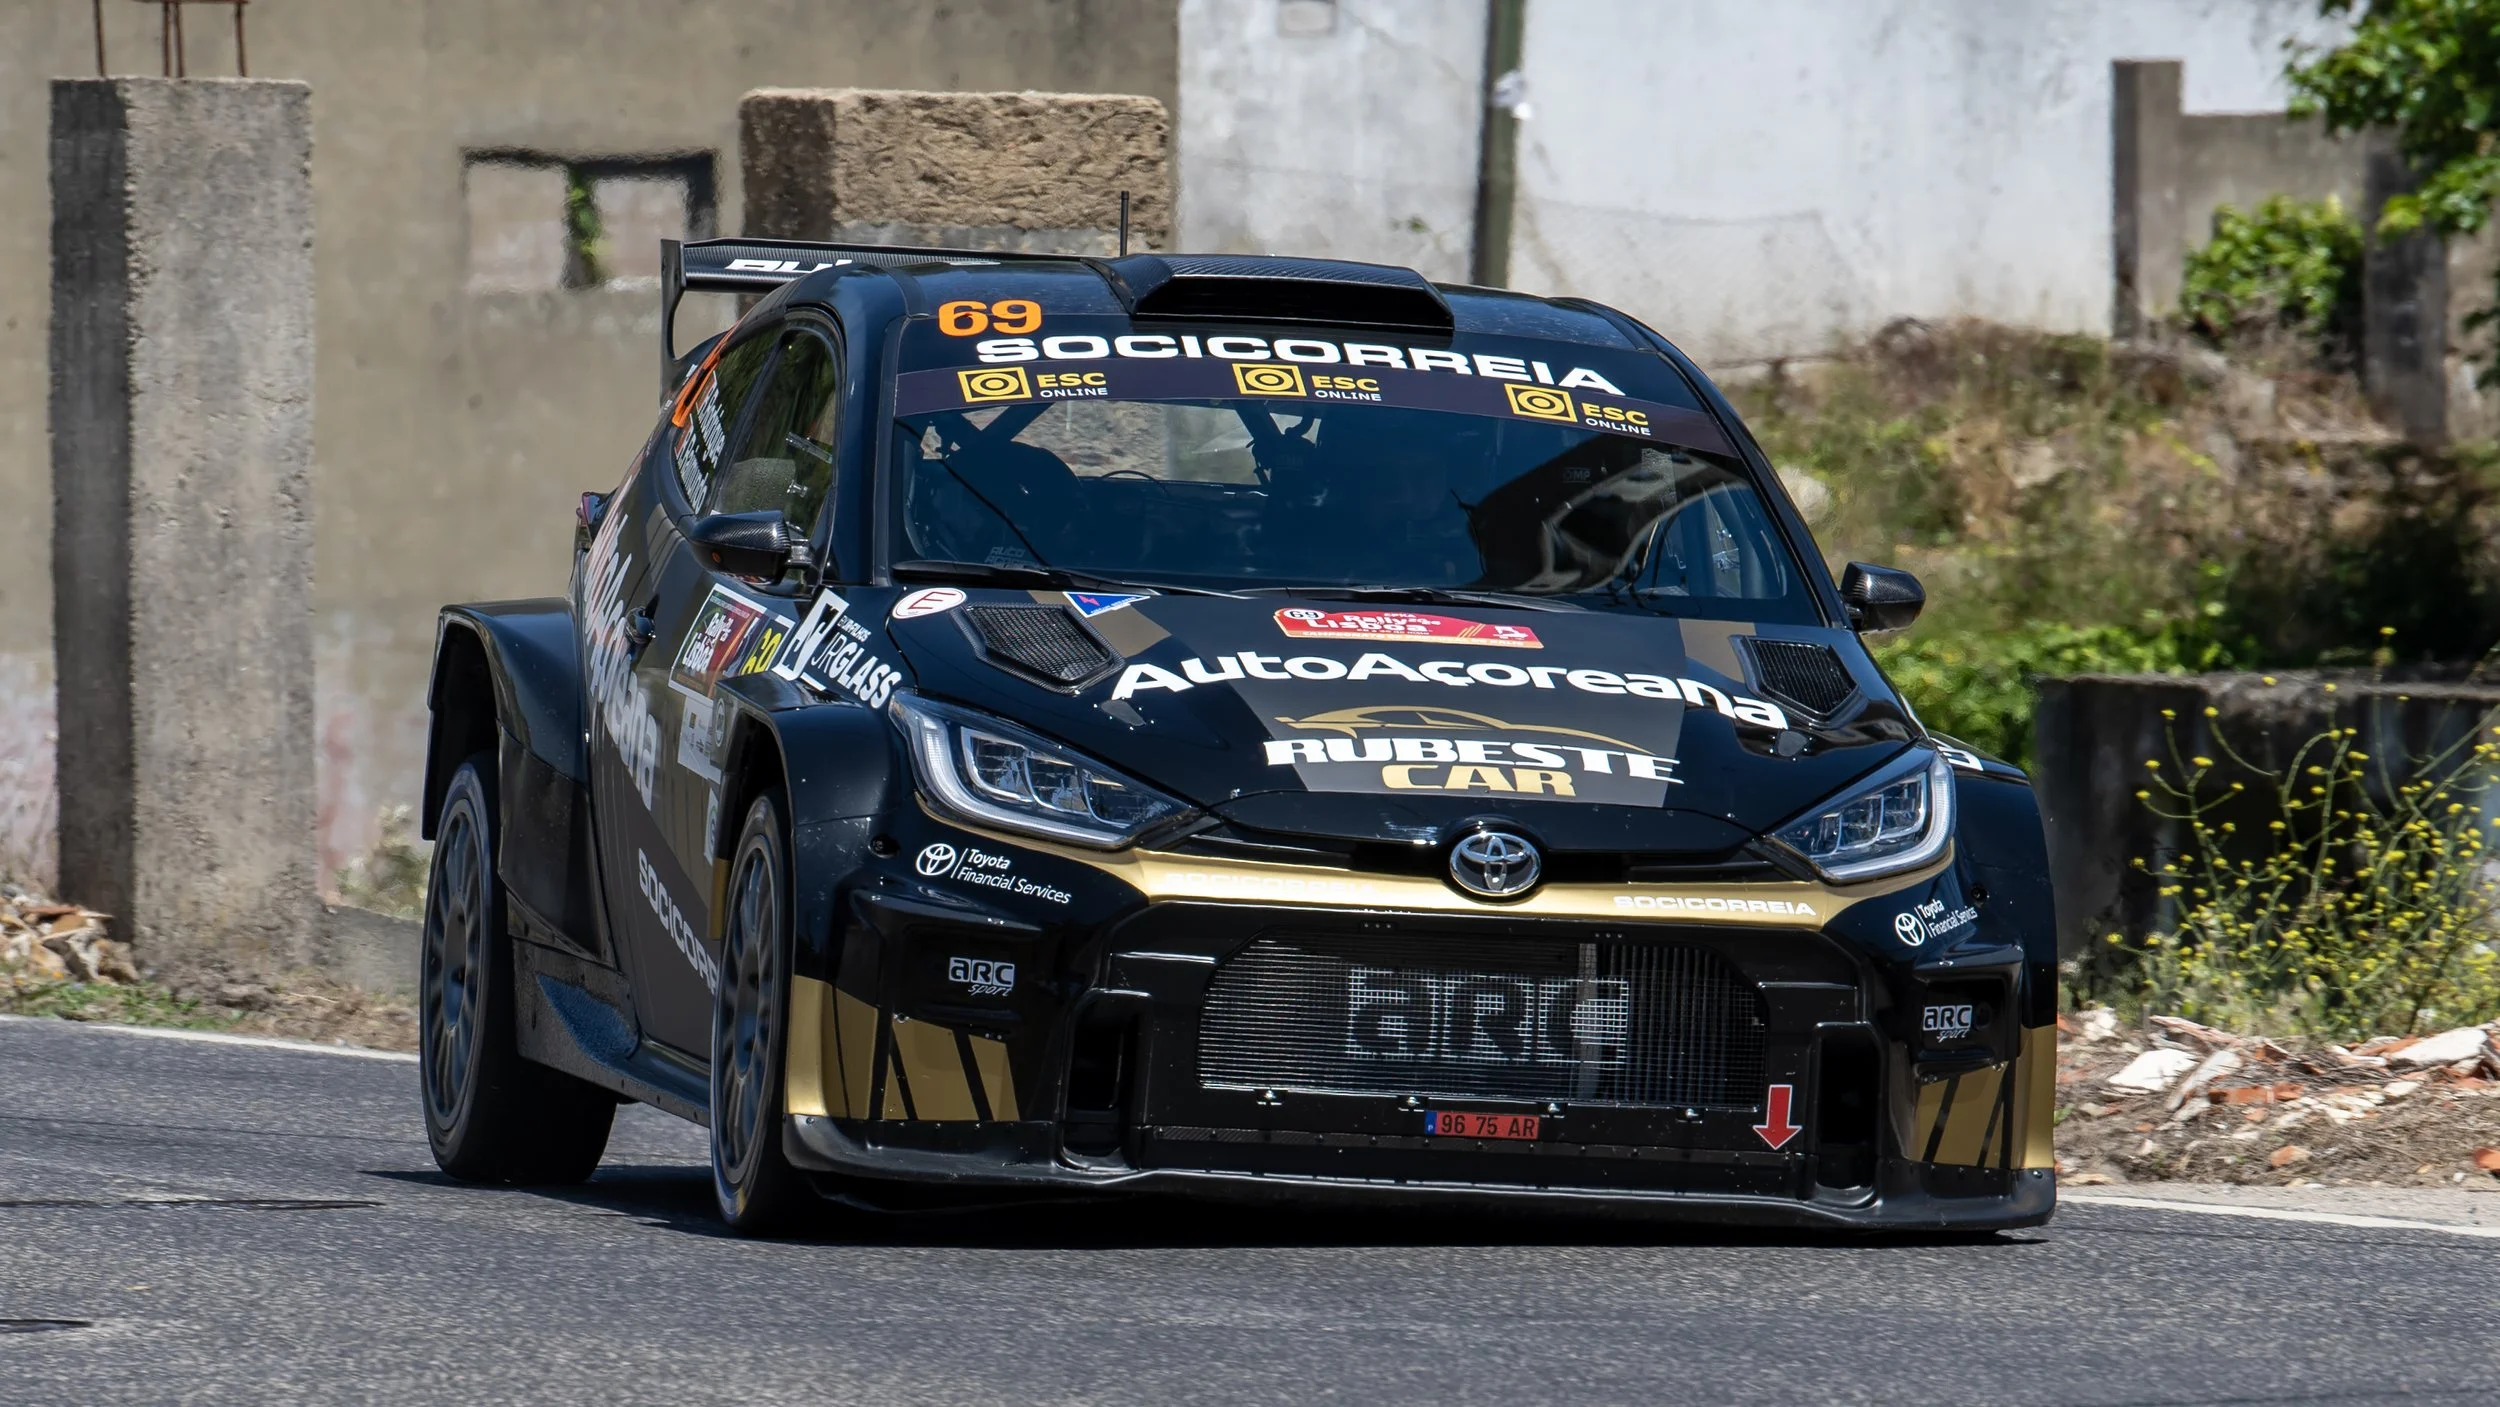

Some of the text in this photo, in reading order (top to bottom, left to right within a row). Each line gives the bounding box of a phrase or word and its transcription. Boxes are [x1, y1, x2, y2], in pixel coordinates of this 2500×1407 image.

[938, 300, 1042, 336] 69
[976, 335, 1626, 396] SOCICORREIA
[1036, 371, 1107, 388] ESC
[1311, 375, 1380, 392] ESC
[1040, 387, 1109, 399] ONLINE
[1315, 390, 1382, 402] ONLINE
[1581, 402, 1649, 427] ESC
[1585, 417, 1652, 437] ONLINE
[908, 591, 956, 609] E
[1289, 610, 1319, 619] 69
[1343, 614, 1407, 625] Rally
[1306, 618, 1429, 632] Lisboa
[1111, 651, 1788, 730] AutoAçoreana
[1263, 738, 1684, 785] RUBESTE
[1382, 764, 1576, 796] CAR
[968, 849, 1011, 869] Toyota
[957, 866, 1072, 904] Financial Services
[1163, 872, 1378, 895] SOCICORREIA
[1613, 896, 1816, 916] SOCICORREIA
[1917, 899, 1945, 919] Toyota
[1928, 906, 1978, 937] Financial Services
[968, 983, 1012, 996] sport
[1936, 1028, 1969, 1043] sport
[1441, 1114, 1536, 1137] 96 75 AR
